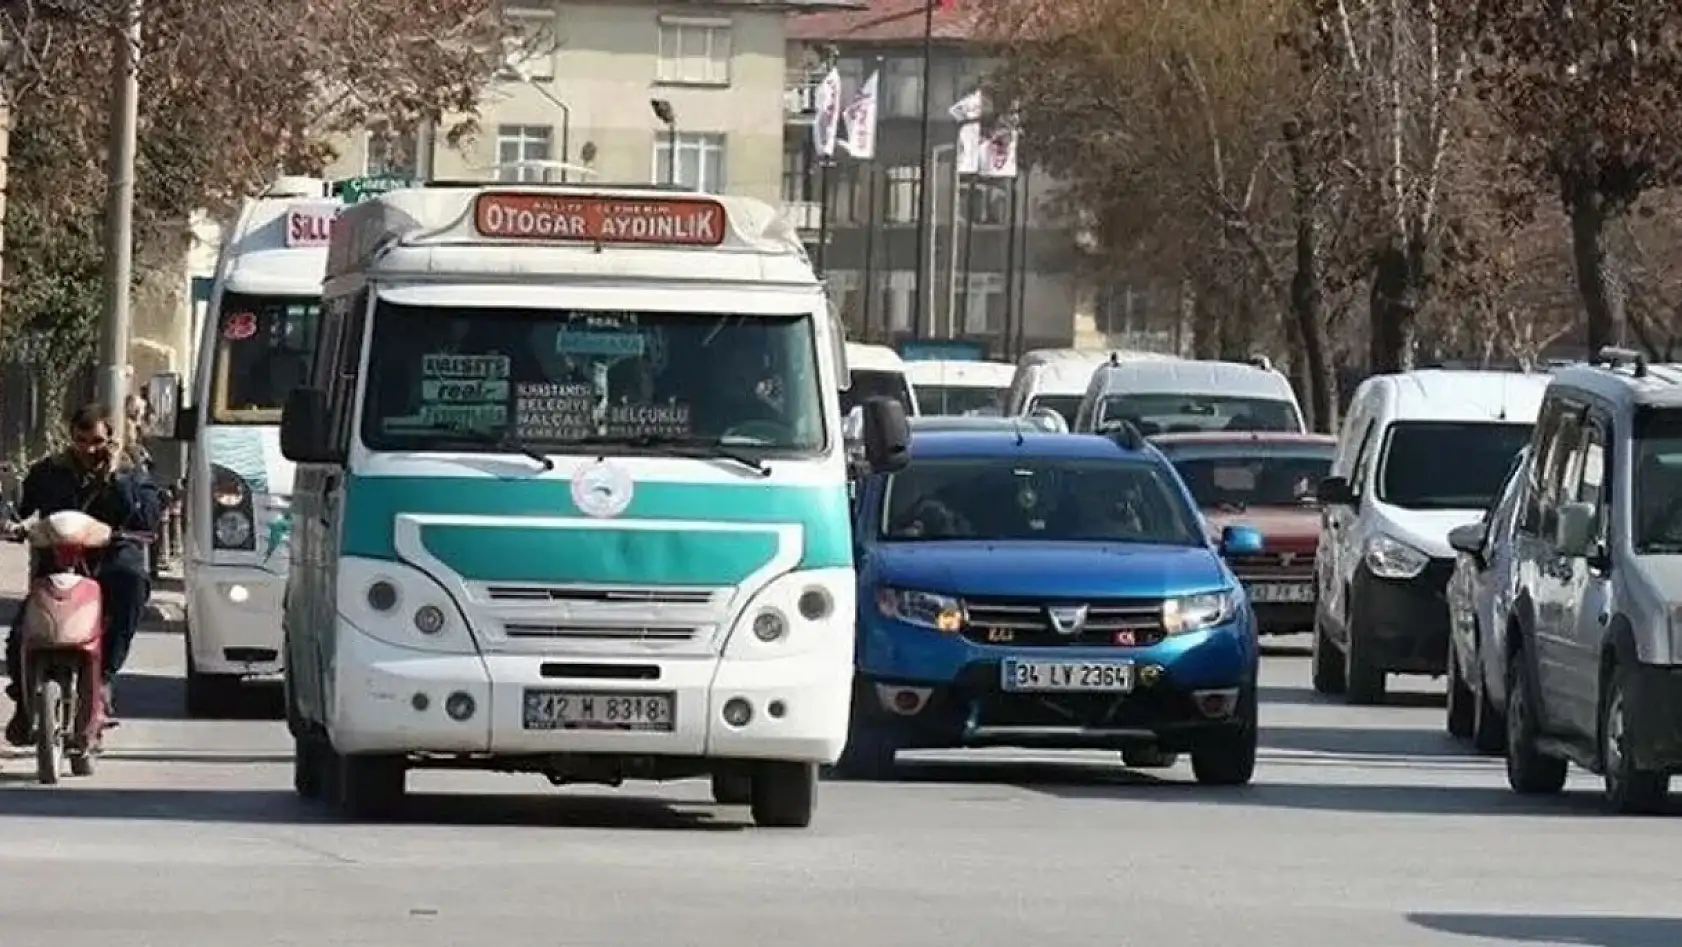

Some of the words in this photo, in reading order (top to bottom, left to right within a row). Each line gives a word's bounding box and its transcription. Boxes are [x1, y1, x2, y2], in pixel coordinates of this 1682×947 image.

[291, 212, 336, 241] SİLL
[486, 203, 587, 235] OTOGAR
[602, 210, 715, 238] AYDINLIK
[1016, 664, 1040, 686] 34
[1079, 664, 1129, 687] 2364
[543, 697, 569, 720] 42
[606, 698, 660, 721] 8318
